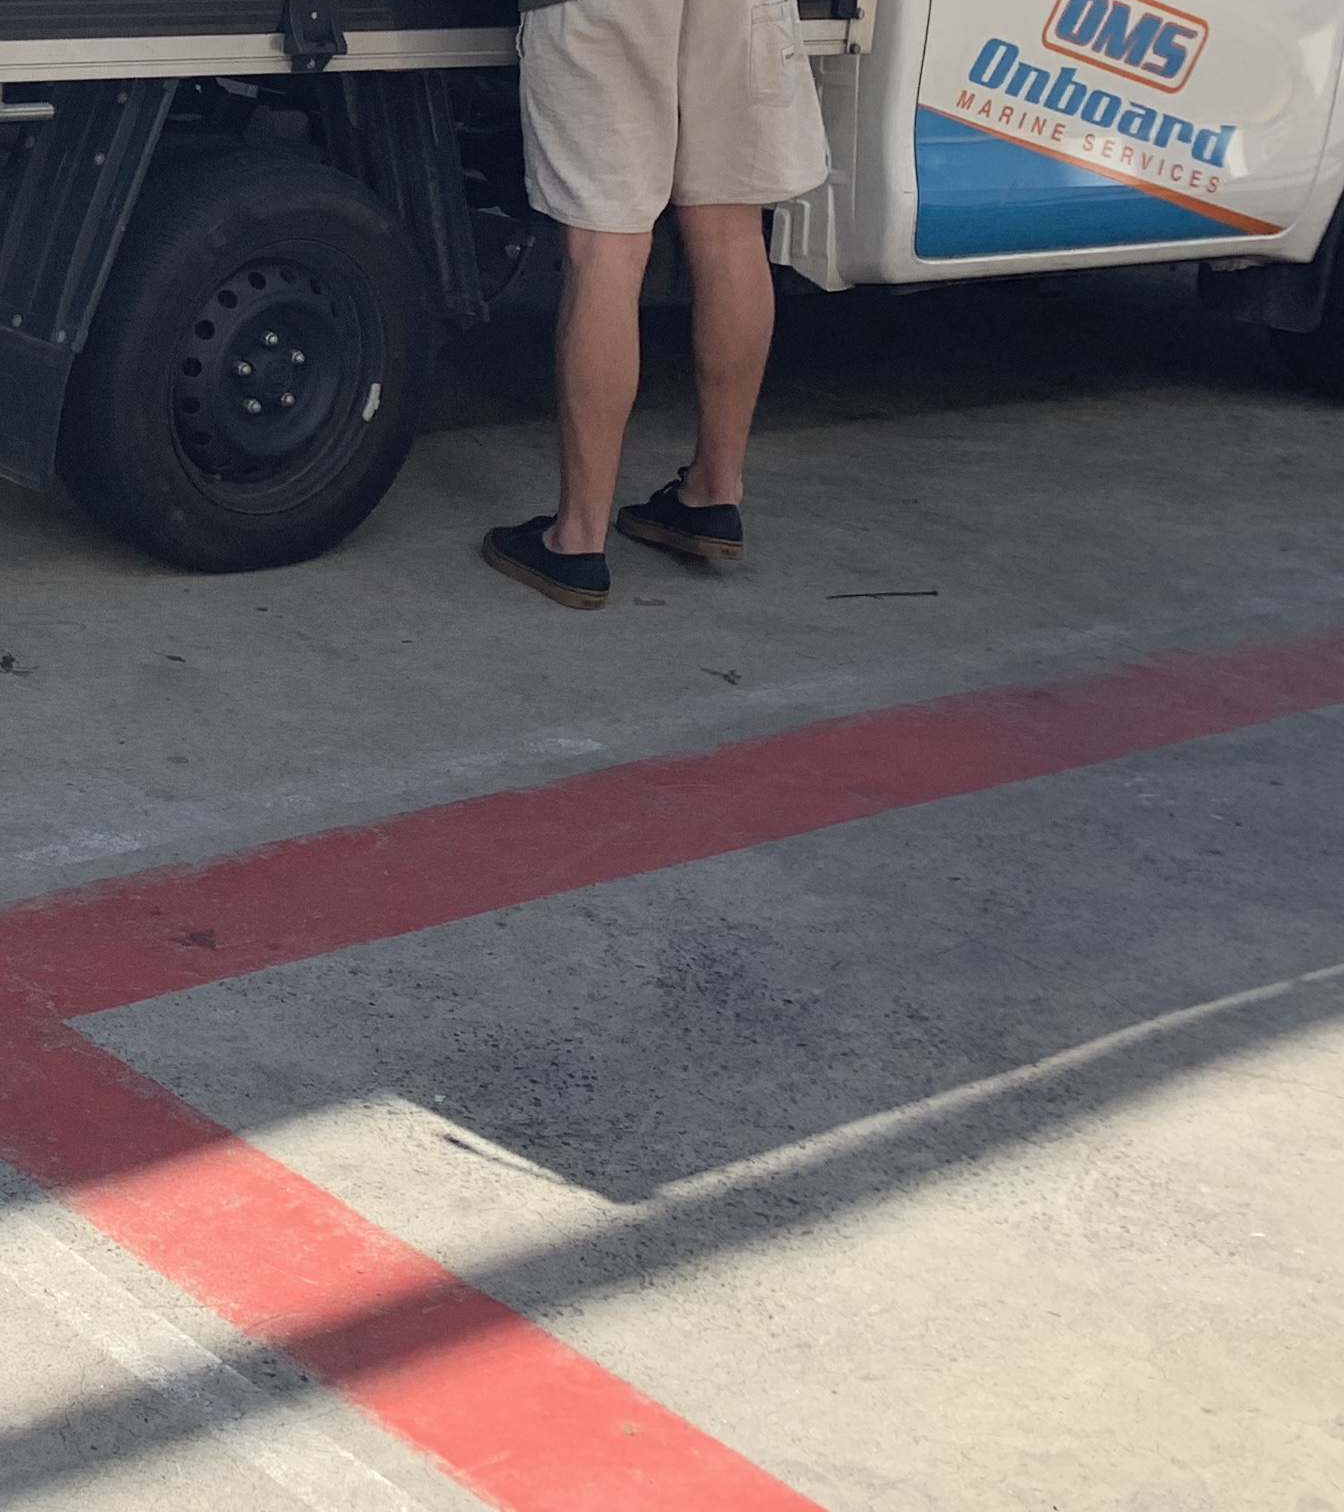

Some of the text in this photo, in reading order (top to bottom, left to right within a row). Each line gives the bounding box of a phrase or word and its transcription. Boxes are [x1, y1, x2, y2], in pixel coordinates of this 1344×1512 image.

[956, 90, 1221, 194] MARINE SERVICES
[968, 37, 1238, 168] Onboard
